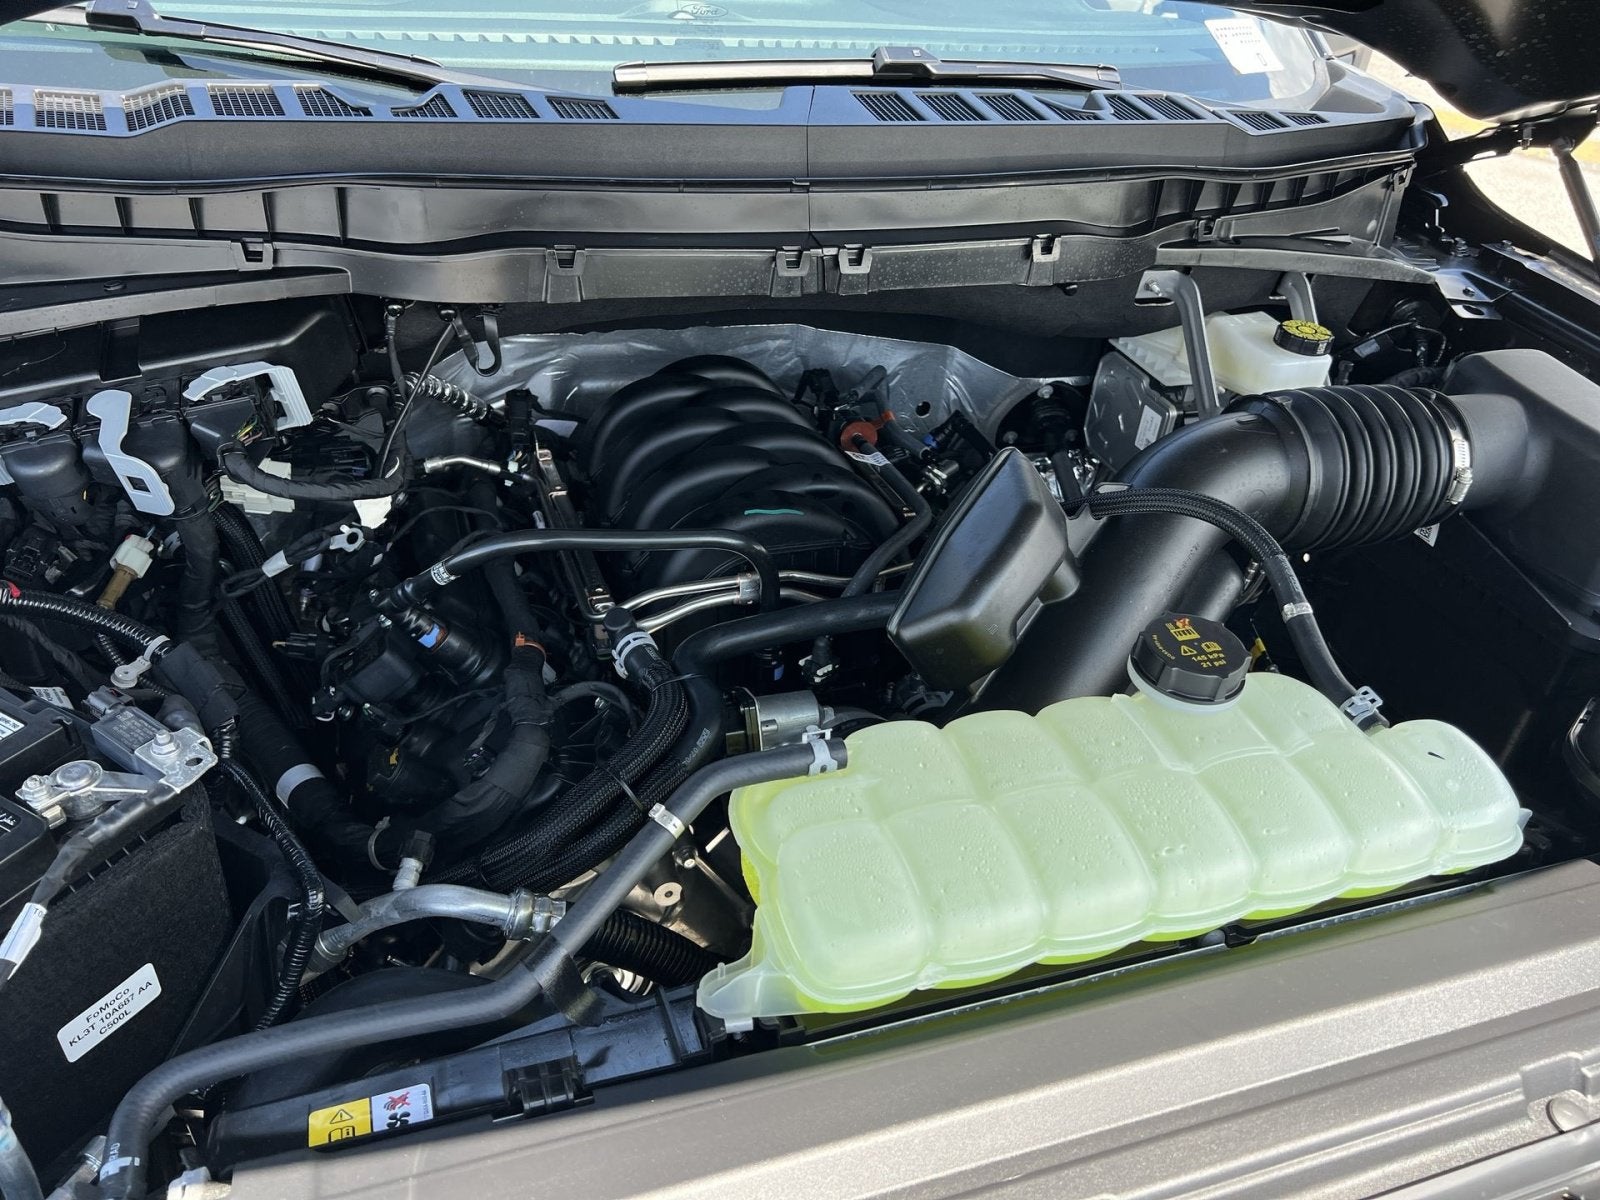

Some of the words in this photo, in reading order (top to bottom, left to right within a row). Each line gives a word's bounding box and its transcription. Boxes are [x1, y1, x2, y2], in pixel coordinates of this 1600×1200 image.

[691, 5, 718, 16] Ford
[1192, 655, 1208, 663] 145
[1213, 659, 1227, 667] psi
[69, 1023, 97, 1047] KL3T
[99, 993, 135, 1024] 10A687
[138, 981, 153, 995] AA
[86, 988, 130, 1023] FoMoCo
[99, 1010, 132, 1035] C500L
